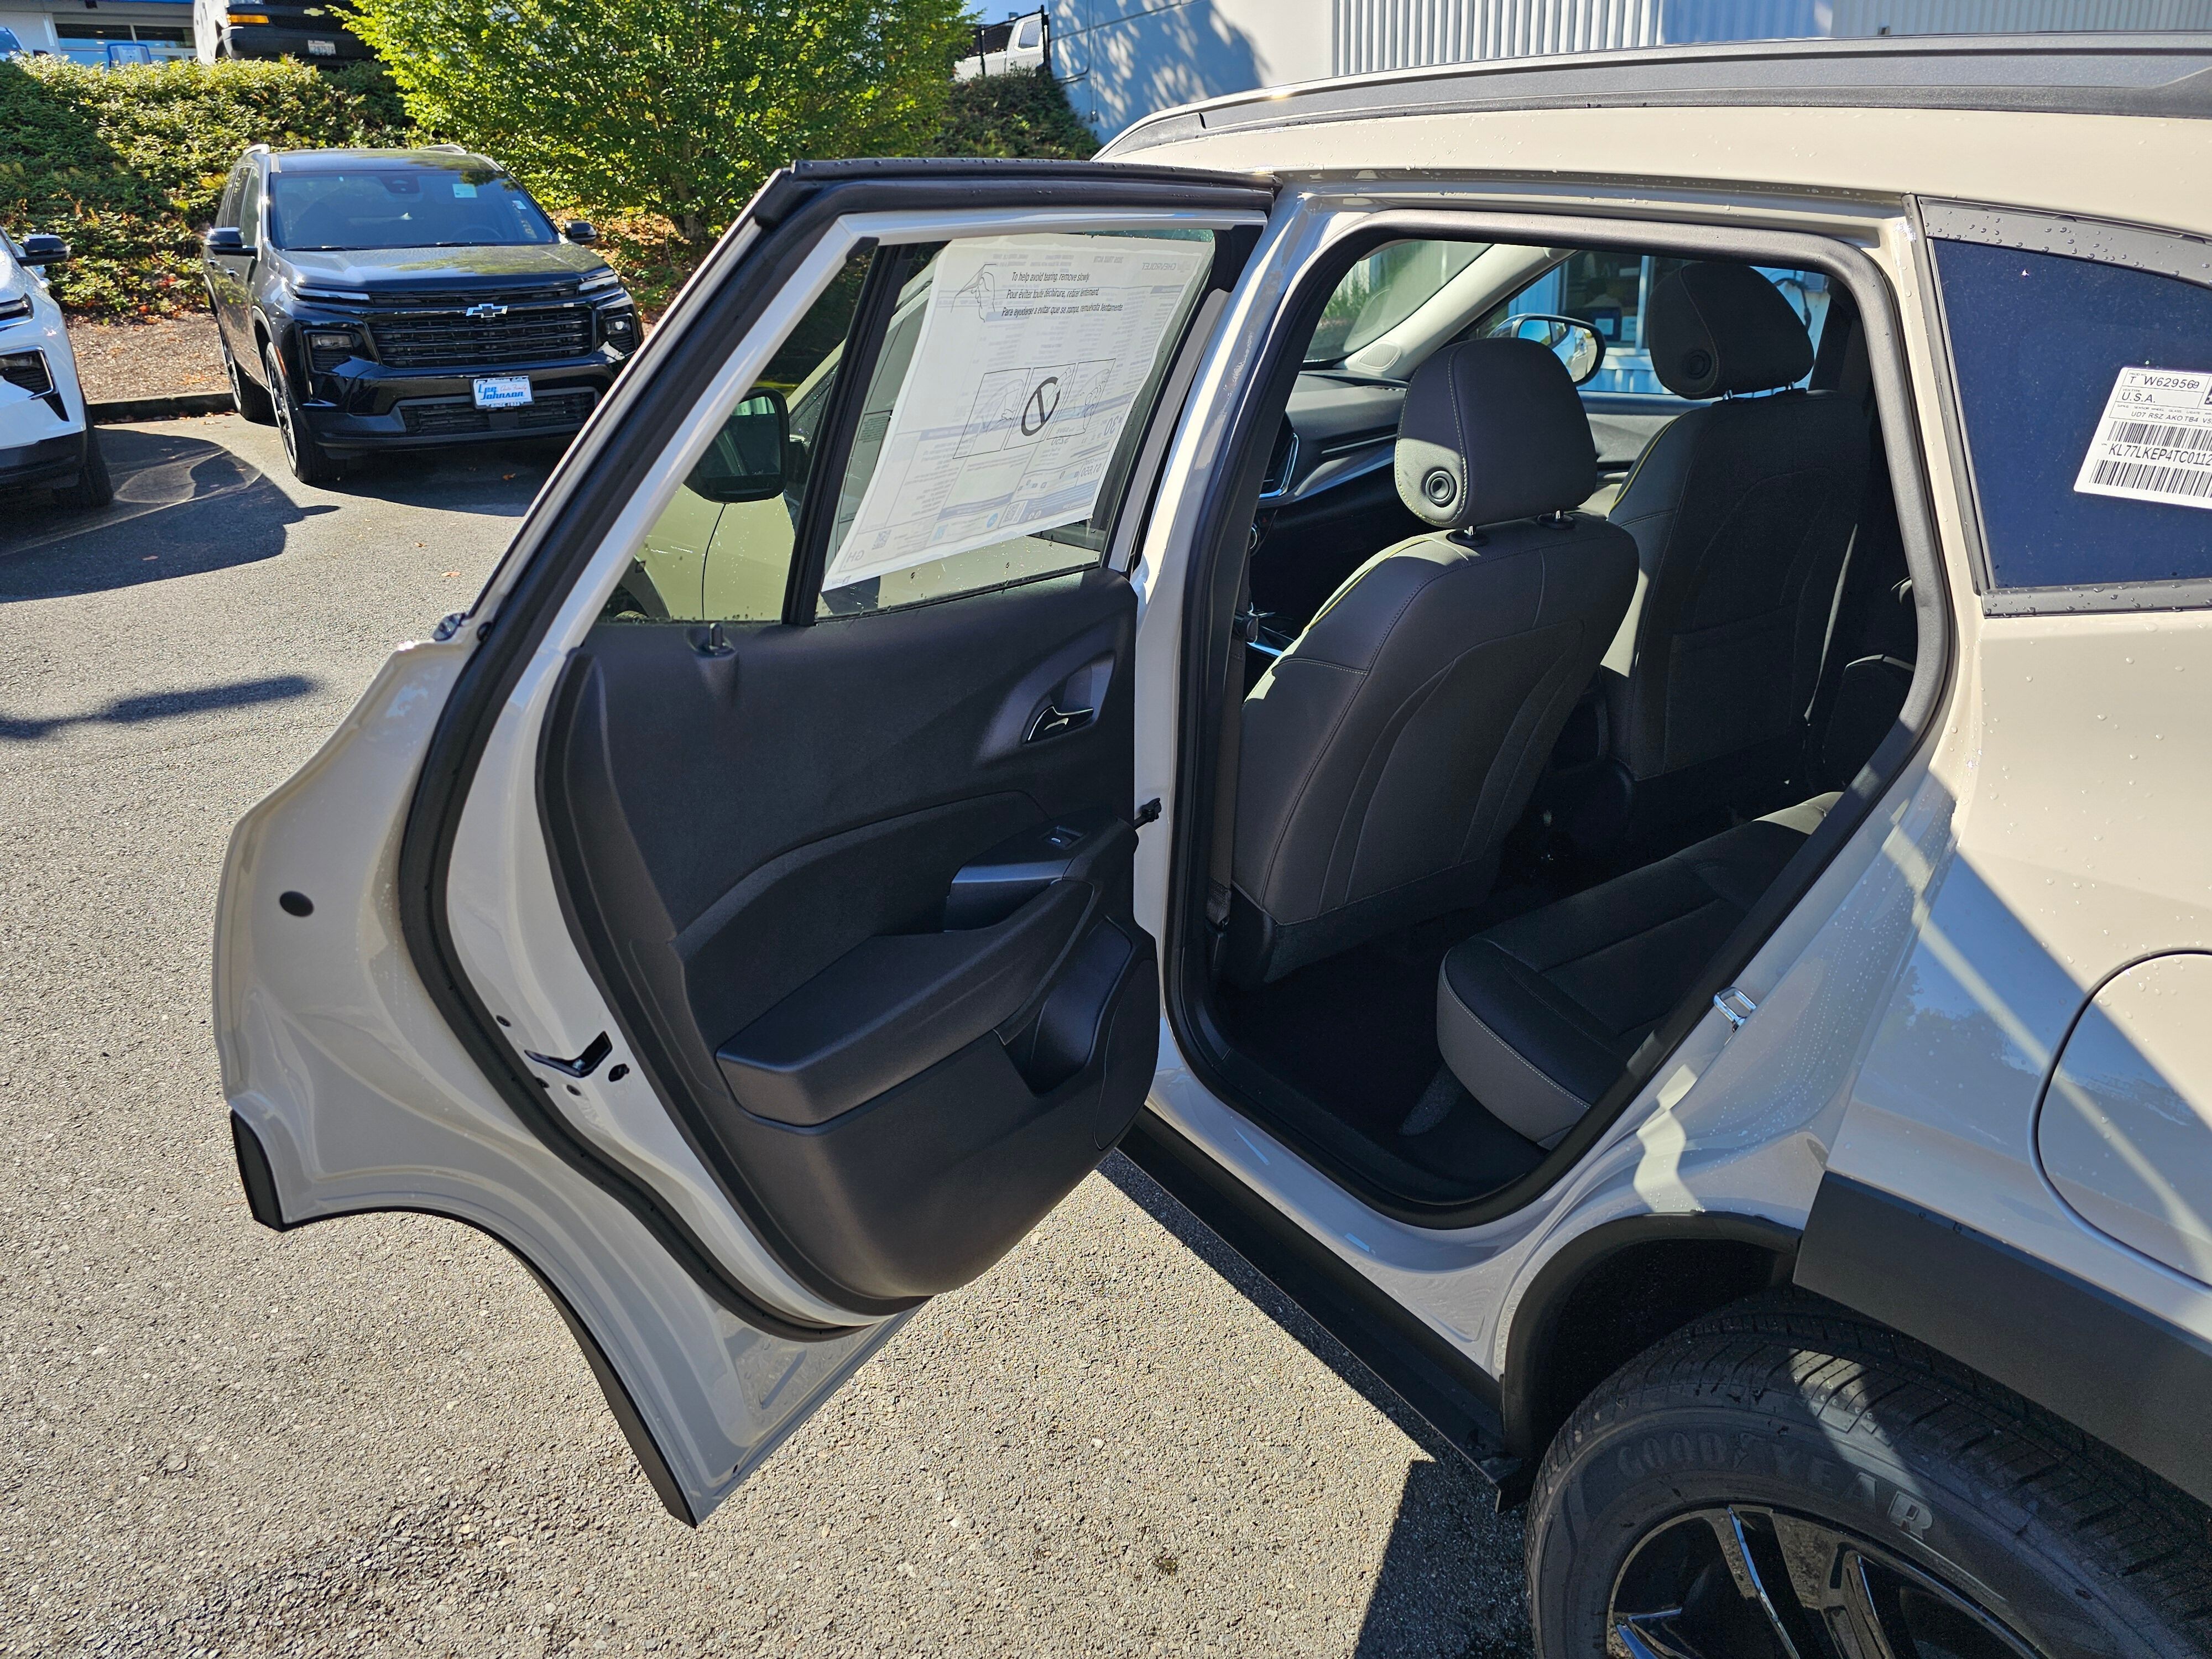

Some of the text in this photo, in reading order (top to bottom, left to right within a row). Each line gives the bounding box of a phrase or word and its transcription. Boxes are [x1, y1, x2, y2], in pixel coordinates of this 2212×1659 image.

[1012, 272, 1018, 281] To
[1018, 272, 1029, 283] help
[1030, 272, 1044, 281] avoid
[1059, 273, 1077, 281] remove
[1006, 289, 1018, 299] Pour
[1019, 288, 1032, 299] éviter
[1001, 307, 1013, 316] Para
[1050, 307, 1060, 316] que
[2144, 375, 2199, 389] W629569
[478, 384, 497, 393] Lee
[481, 388, 524, 400] Johnson
[2122, 392, 2156, 403] U.S.A.
